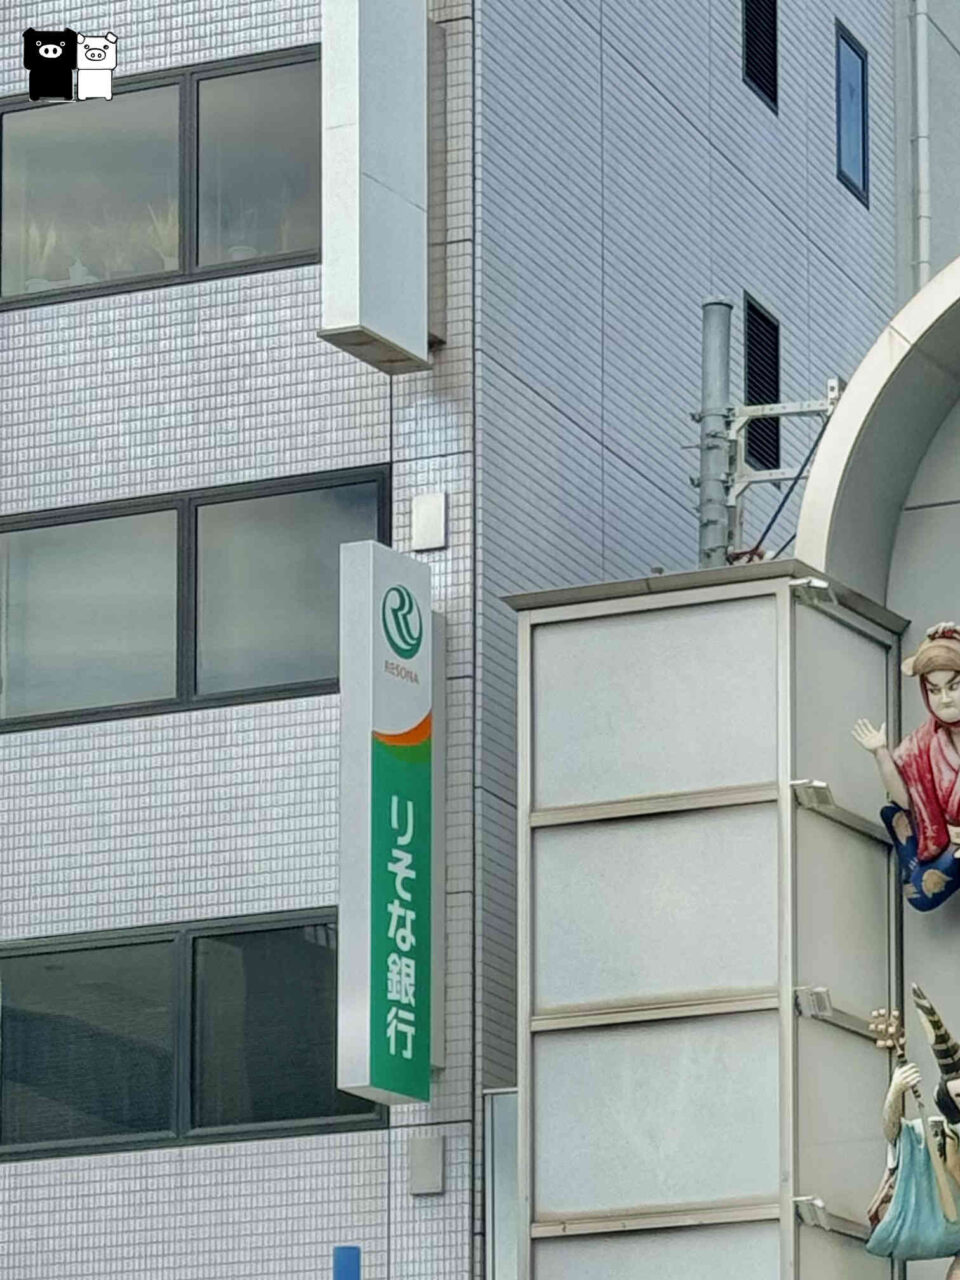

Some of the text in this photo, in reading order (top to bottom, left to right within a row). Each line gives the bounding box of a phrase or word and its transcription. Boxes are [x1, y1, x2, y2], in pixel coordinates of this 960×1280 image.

[384, 659, 420, 684] RESONA
[386, 795, 416, 1060] りそな銀行
